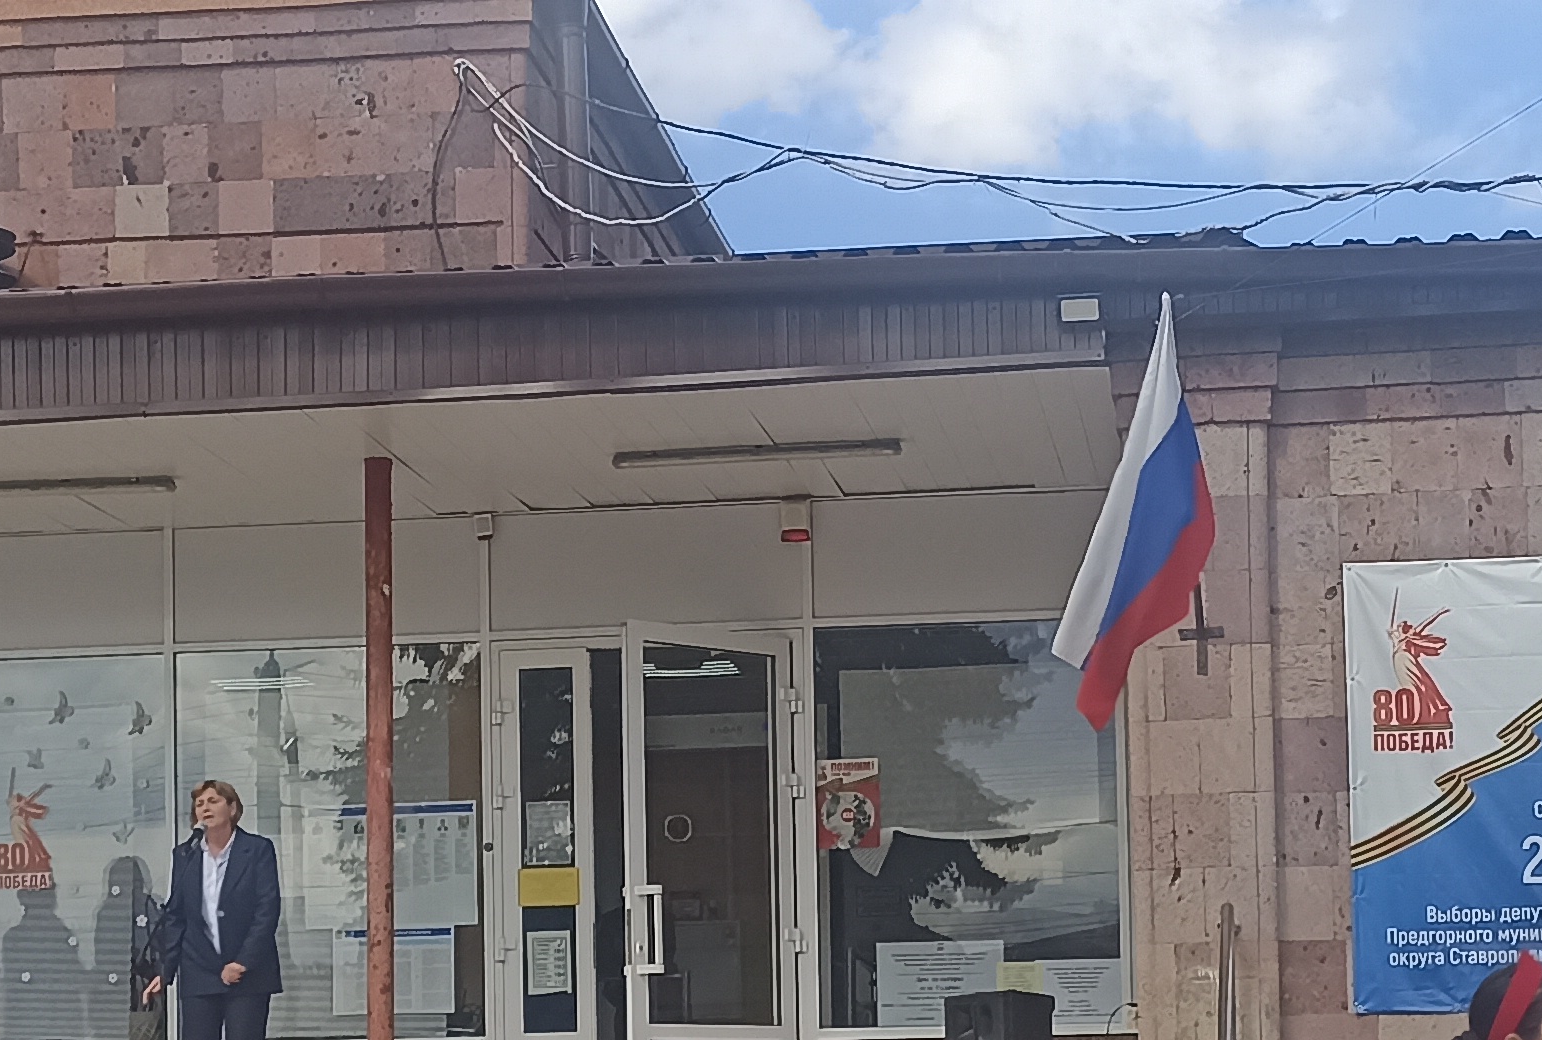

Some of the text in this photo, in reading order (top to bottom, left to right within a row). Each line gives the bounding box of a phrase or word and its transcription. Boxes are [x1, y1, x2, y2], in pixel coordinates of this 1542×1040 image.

[1373, 688, 1415, 725] 80
[1373, 731, 1454, 753] ПОБЕДА!
[1426, 906, 1495, 925] Выборы
[1386, 928, 1493, 947] Предгорного
[1389, 951, 1445, 969] округа
